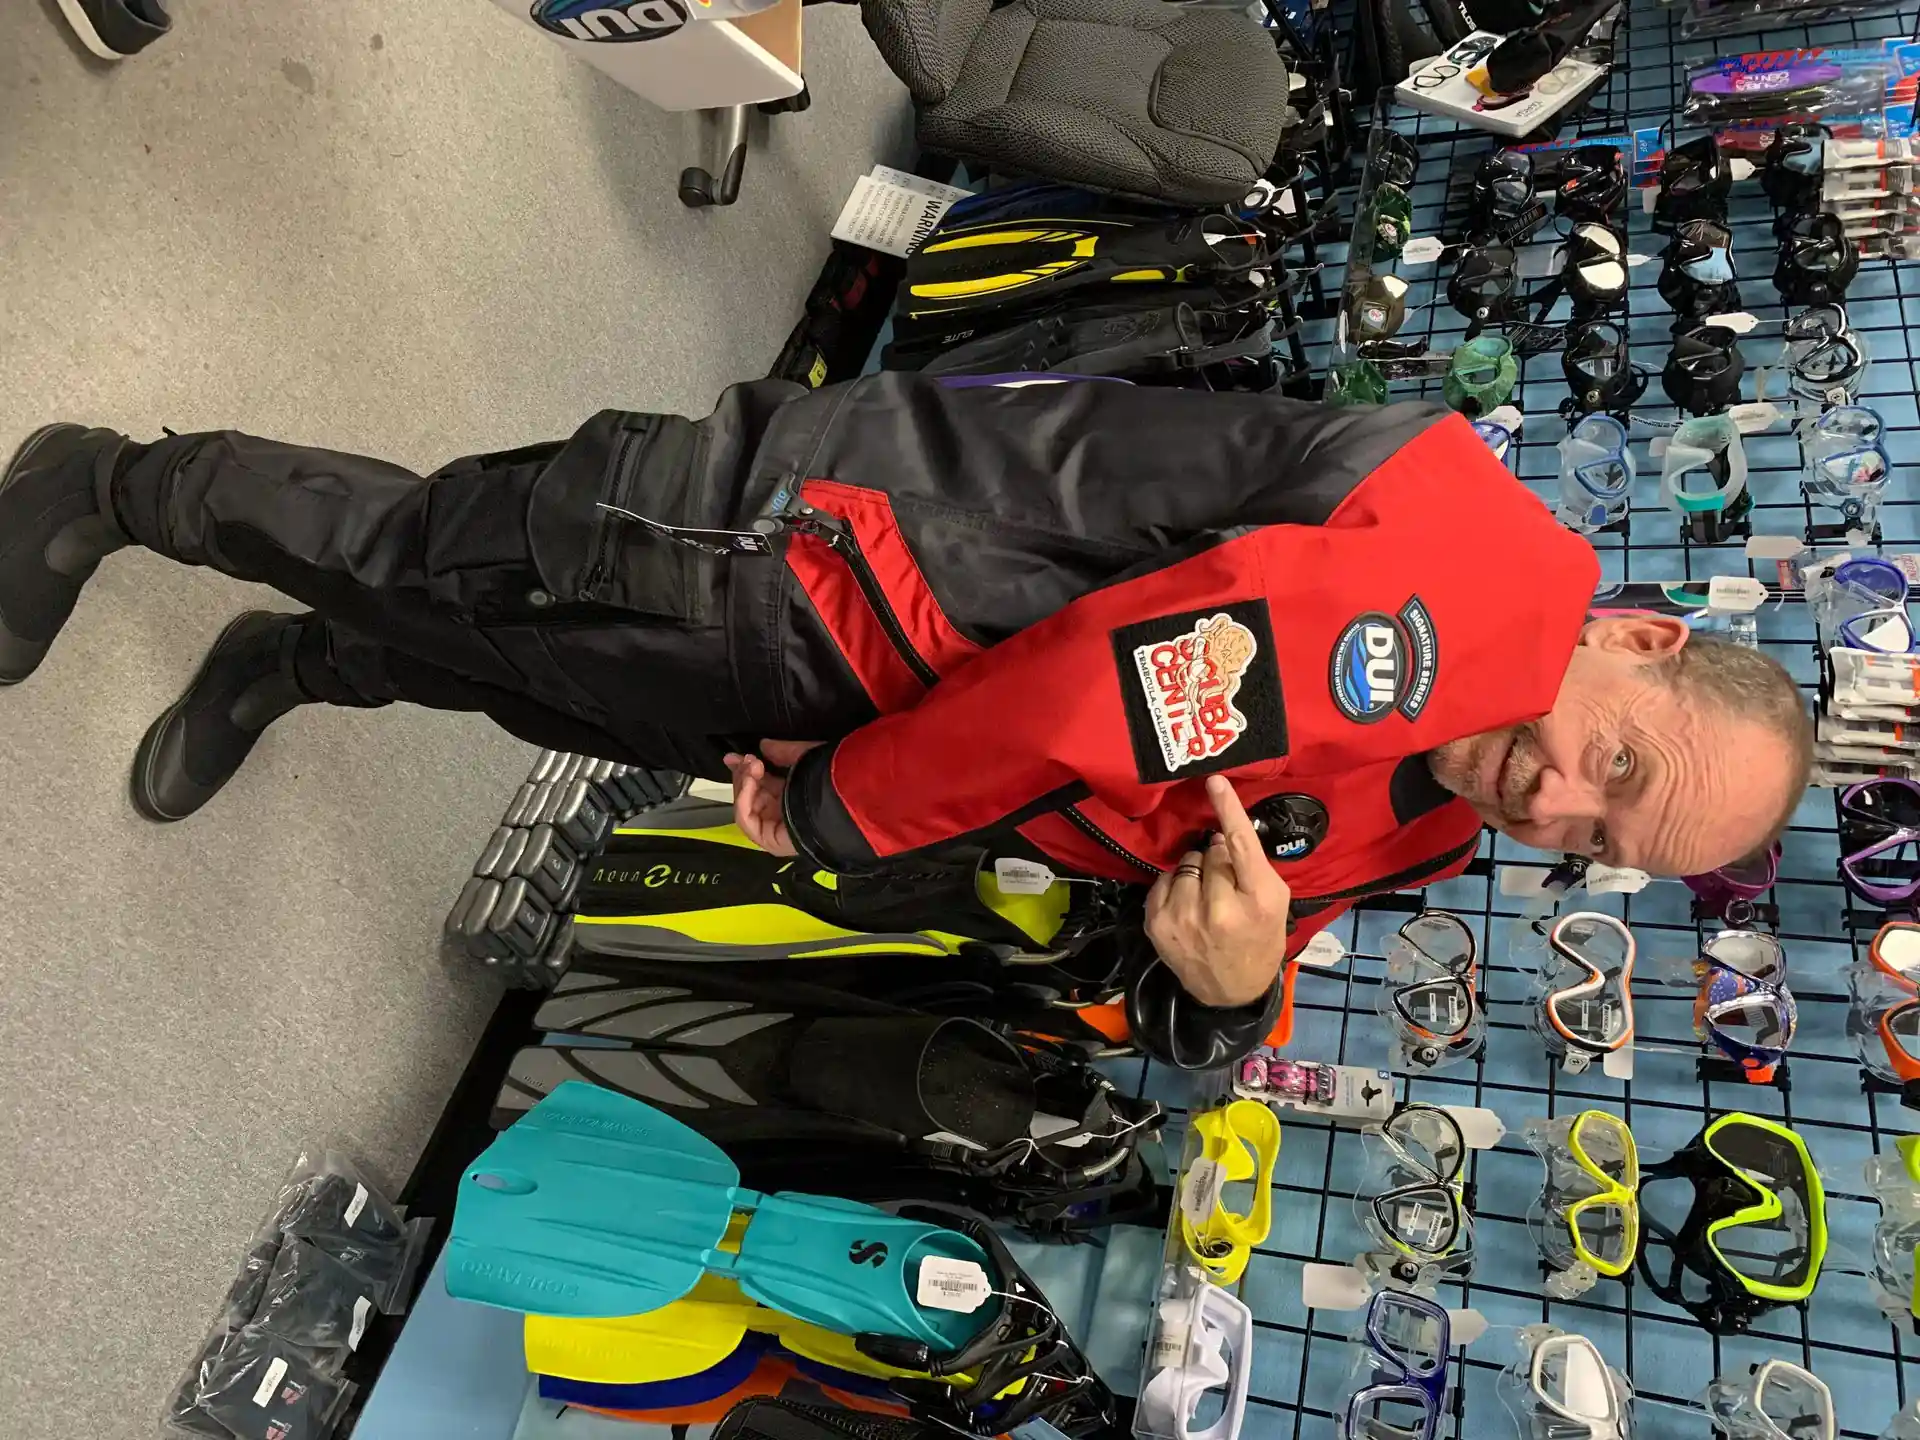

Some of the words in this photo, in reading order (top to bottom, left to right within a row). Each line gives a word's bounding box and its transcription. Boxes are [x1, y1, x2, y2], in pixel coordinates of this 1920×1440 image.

[560, 0, 684, 40] DUI
[1458, 1, 1477, 31] TILOS
[737, 536, 759, 551] DUI
[1343, 622, 1361, 641] DIVING
[1409, 609, 1432, 668] SIGNATURE
[1335, 642, 1346, 675] UNLIMITED
[1365, 626, 1394, 702] DUI
[1136, 650, 1157, 706] TEMECULA,
[1153, 706, 1177, 767] CALIFORNIA
[1151, 644, 1206, 761] CENTER
[1179, 639, 1236, 753] SCUBA
[1335, 676, 1358, 716] INTERNATIONAL
[1409, 670, 1430, 709] SERIES
[1275, 837, 1306, 856] DUI
[592, 868, 640, 883] AQUA
[673, 870, 722, 885] LUNG
